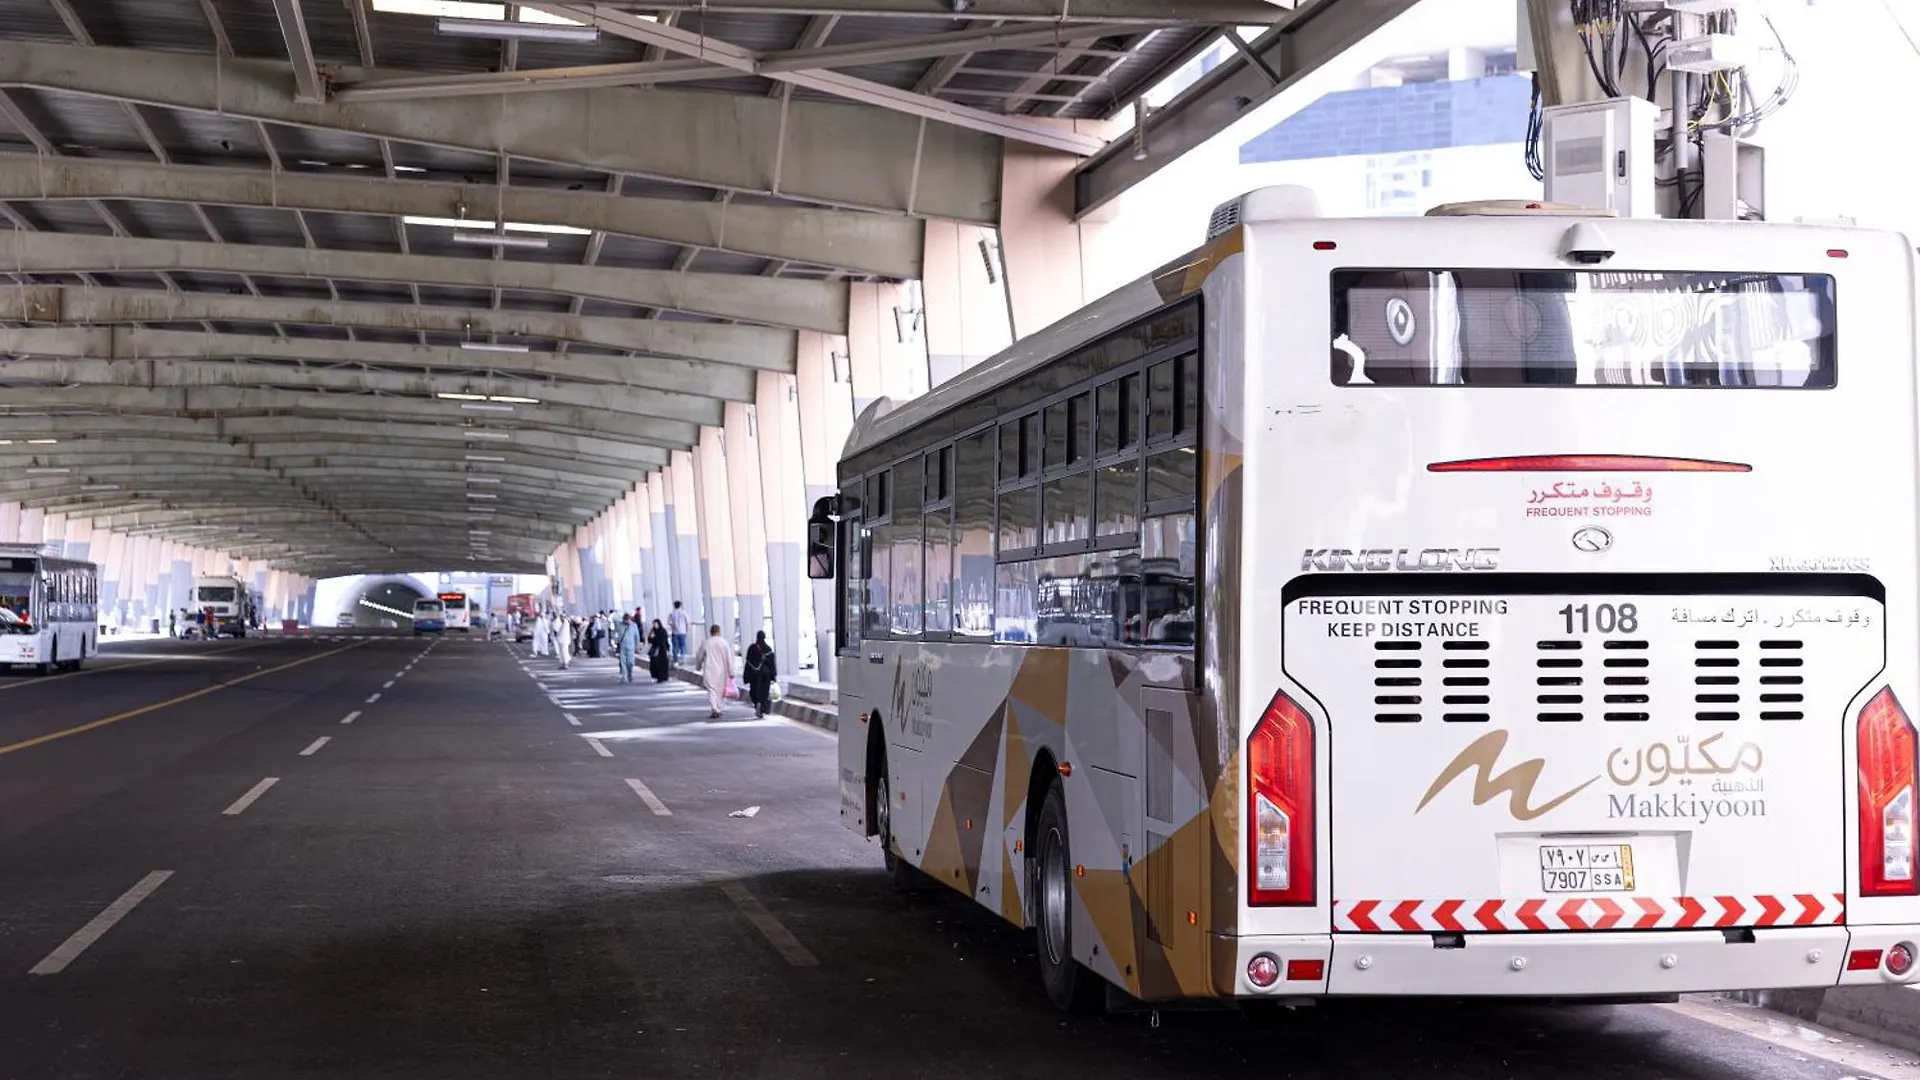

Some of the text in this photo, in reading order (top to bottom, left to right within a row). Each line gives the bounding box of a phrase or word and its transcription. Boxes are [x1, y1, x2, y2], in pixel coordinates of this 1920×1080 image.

[1525, 481, 1653, 504] وقوف متكرر
[1526, 506, 1651, 517] FREQUENT STOPPING
[1300, 547, 1501, 572] KING LONG
[1298, 599, 1508, 616] FREQUENT STOPPING
[1558, 602, 1638, 634] 1108
[1826, 607, 1872, 628] وقوف
[1327, 622, 1479, 638] KEEP DISTANCE
[1607, 792, 1766, 825] Makkiyoon
[1548, 870, 1587, 889] 7907
